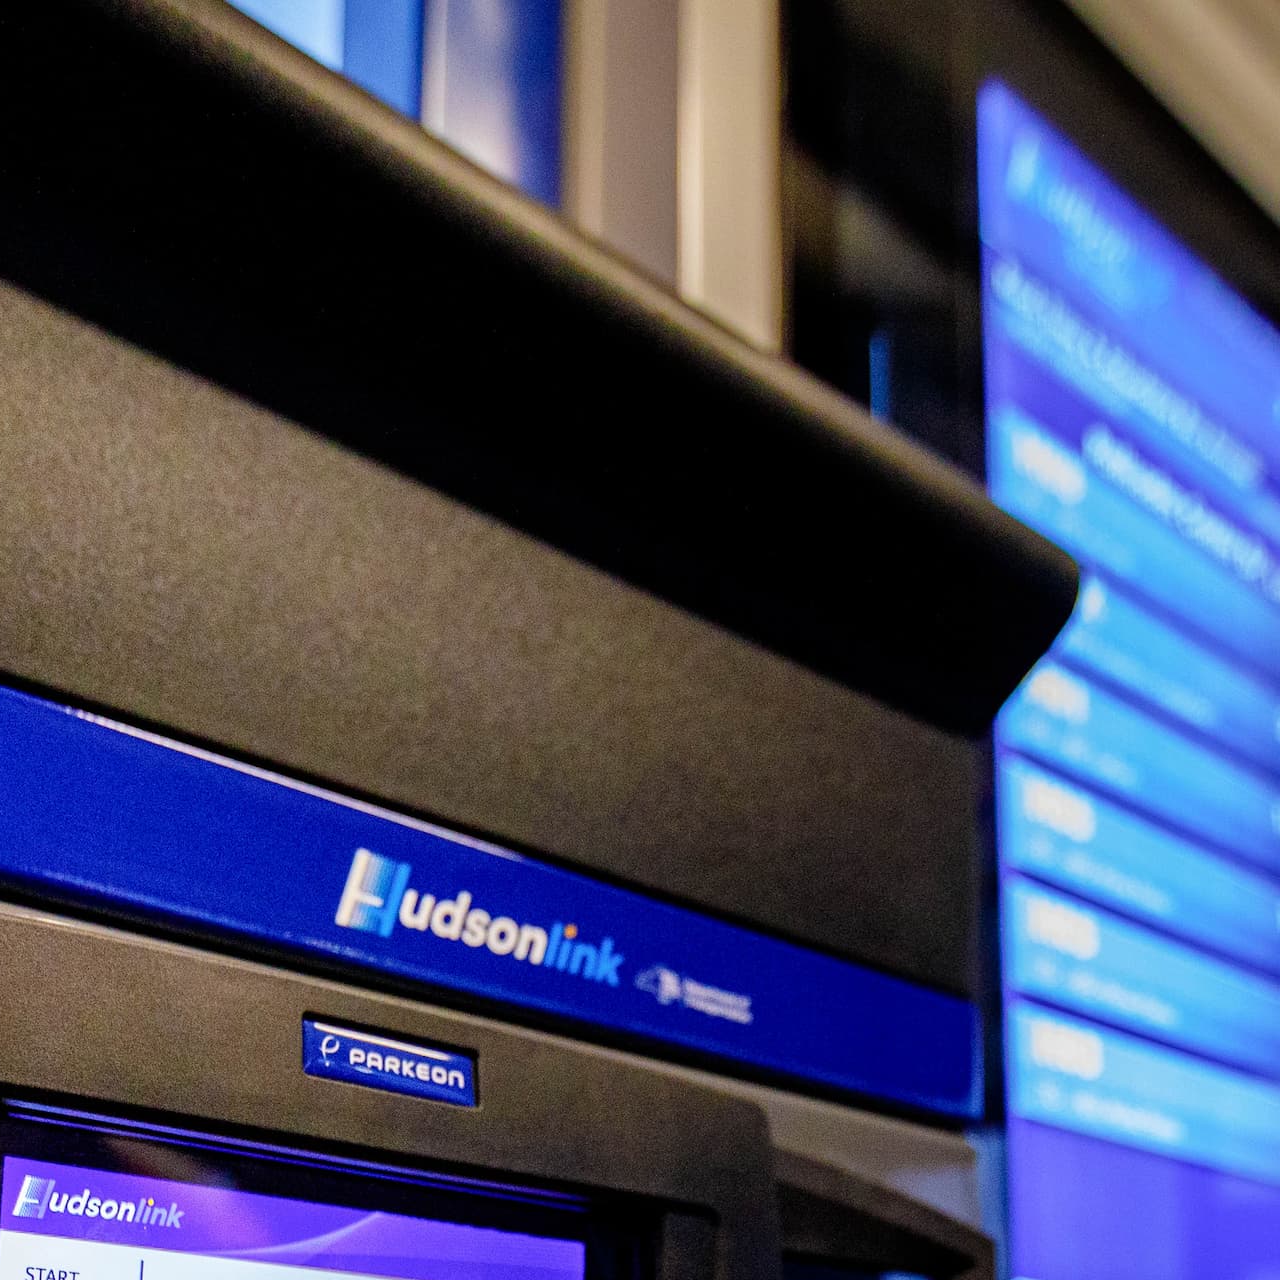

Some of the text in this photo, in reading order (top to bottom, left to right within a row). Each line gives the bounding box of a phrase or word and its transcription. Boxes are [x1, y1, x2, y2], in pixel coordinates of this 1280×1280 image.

[333, 847, 624, 987] Hudsonlink
[349, 1048, 465, 1089] PARKEON
[12, 1174, 186, 1229] Hudsonlink
